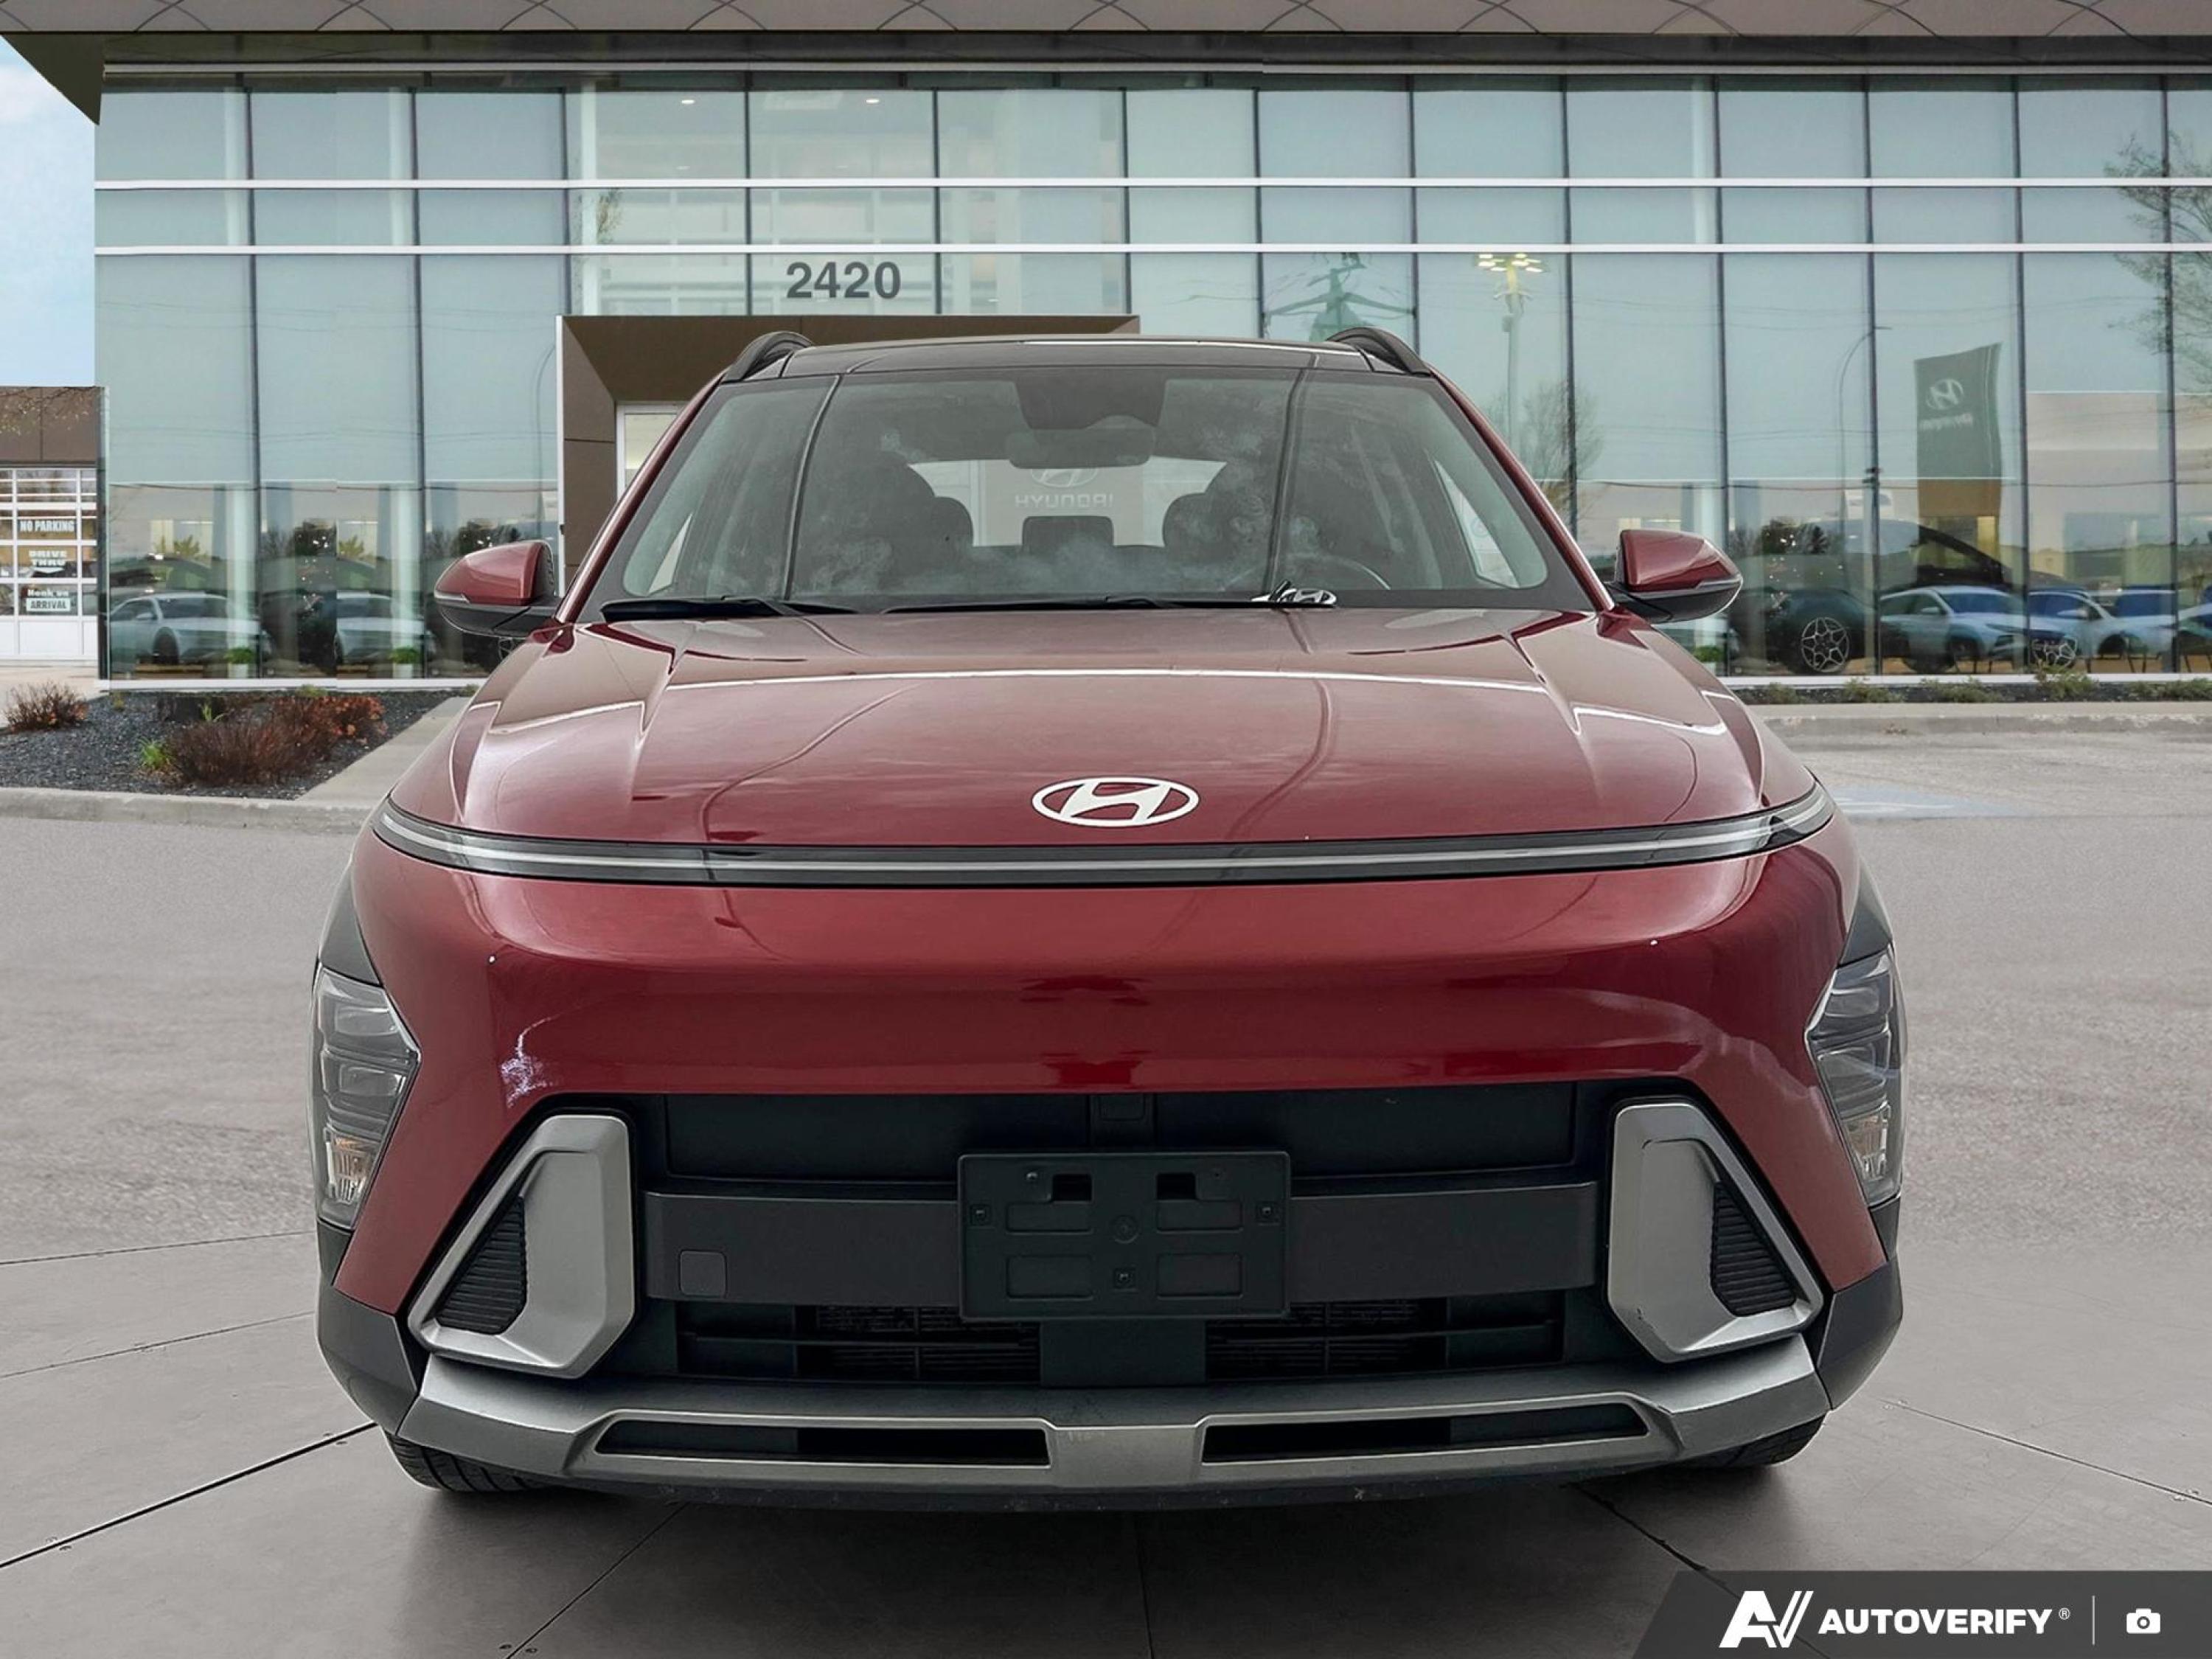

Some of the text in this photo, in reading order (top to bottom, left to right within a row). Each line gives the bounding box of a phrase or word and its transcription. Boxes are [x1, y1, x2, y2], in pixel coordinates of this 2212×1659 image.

[786, 261, 901, 299] 2420
[1014, 493, 1113, 508] HYUNDAI
[20, 520, 74, 532] NO PARKING
[29, 550, 67, 558] DRIVE
[30, 600, 67, 609] ARRIVAL
